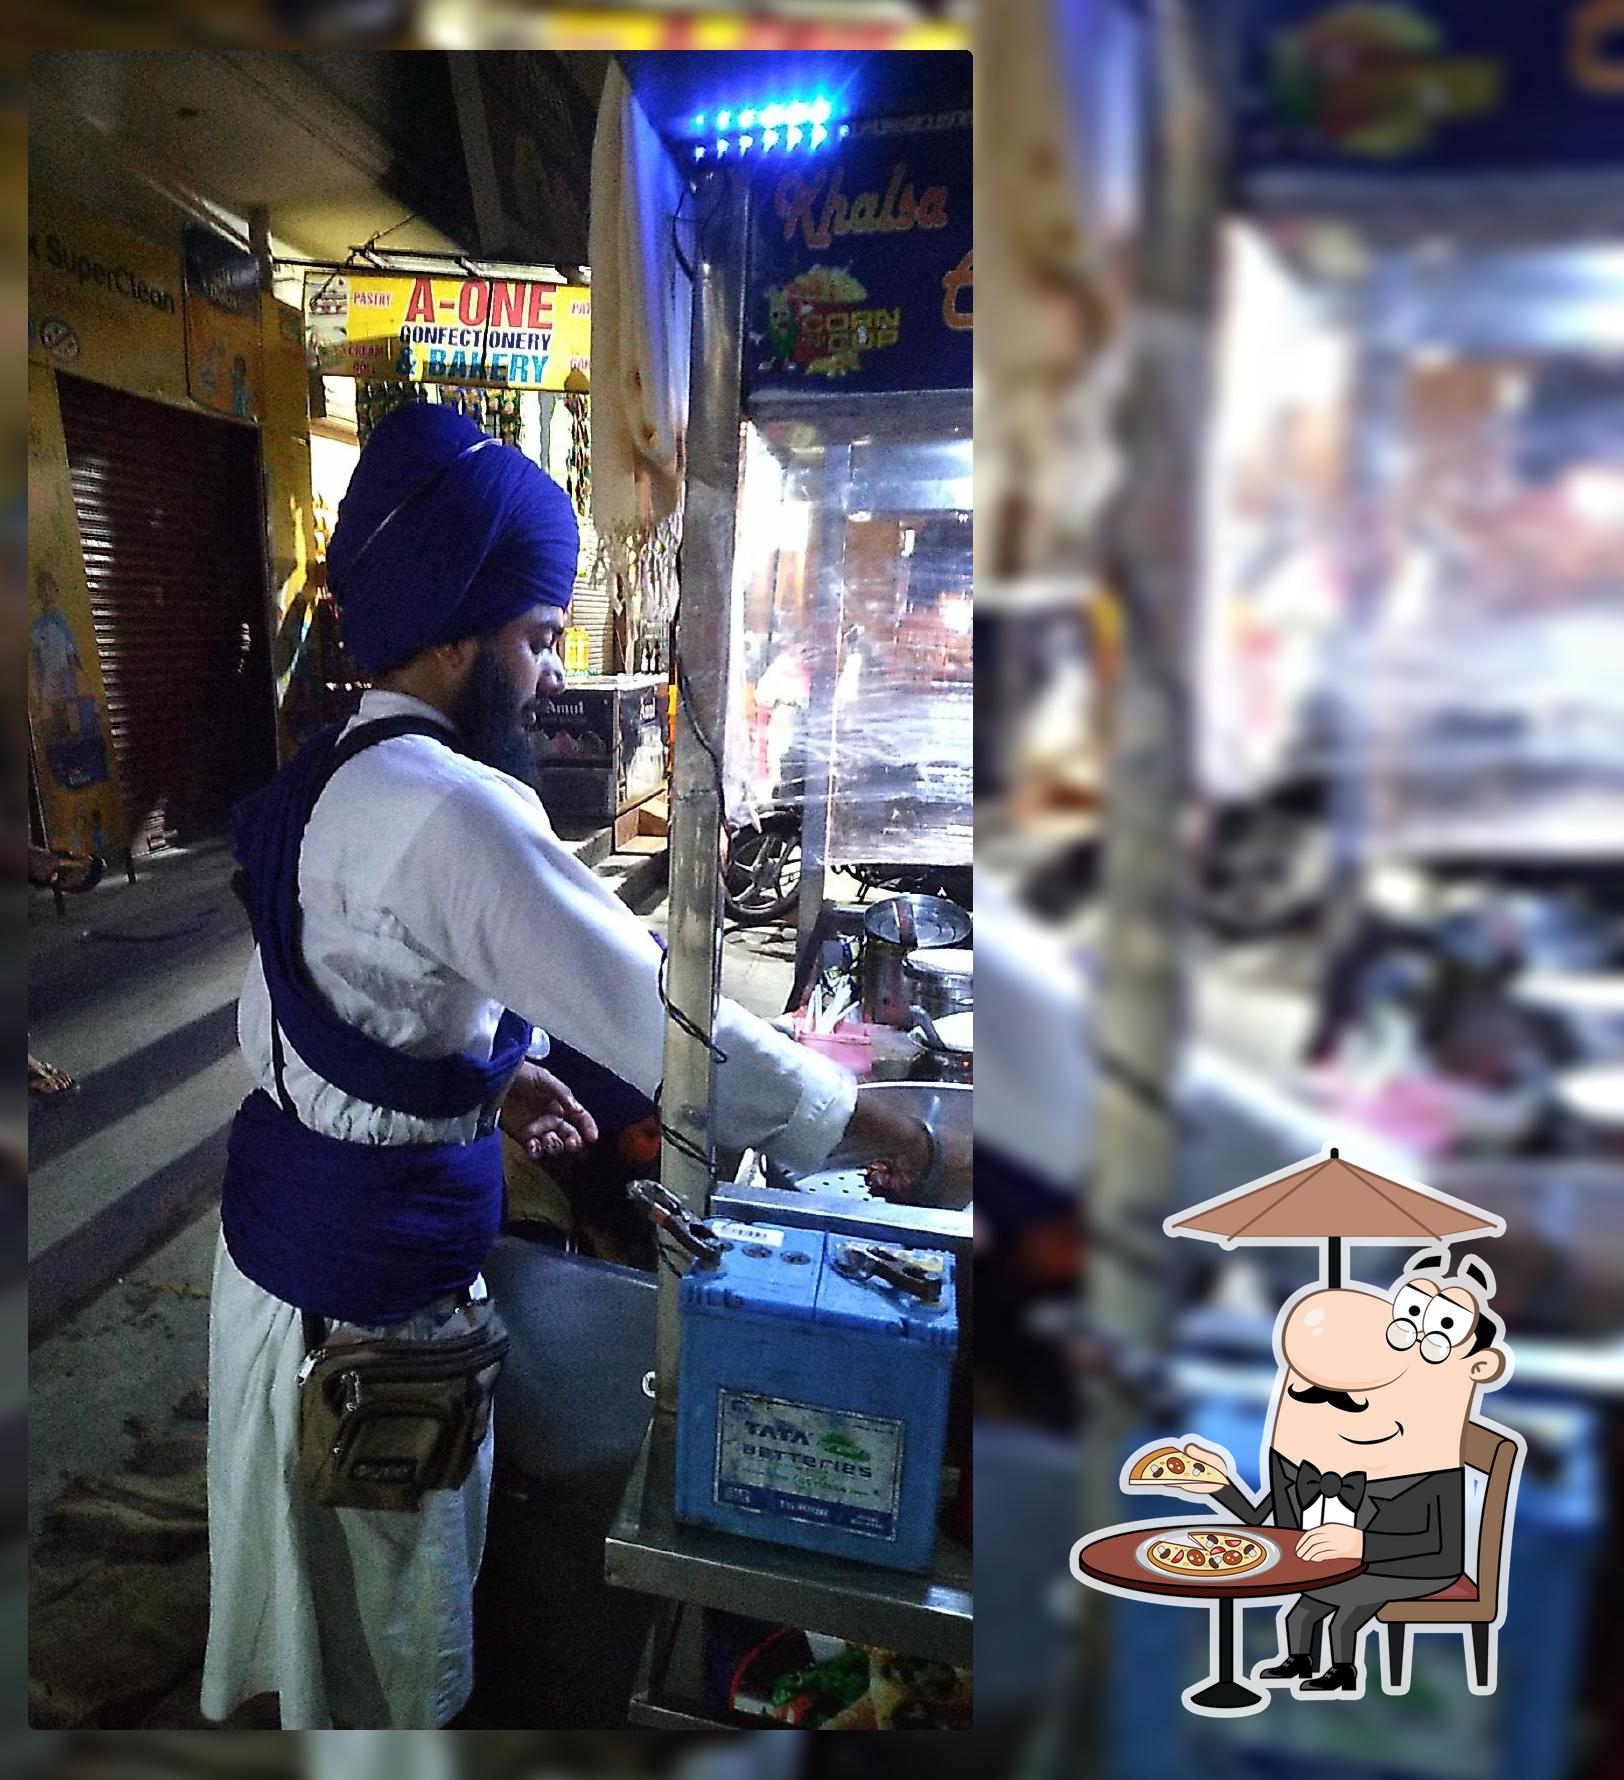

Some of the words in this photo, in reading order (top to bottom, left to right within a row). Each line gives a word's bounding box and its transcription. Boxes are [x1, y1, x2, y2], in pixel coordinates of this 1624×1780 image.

[775, 161, 948, 249] Khalsa
[353, 291, 392, 306] PASTRY
[405, 278, 556, 329] A-ONE
[400, 325, 552, 351] CONFECTIONERY
[396, 347, 416, 376] &
[428, 348, 549, 384] BAKERY
[744, 1419, 811, 1446] TATA
